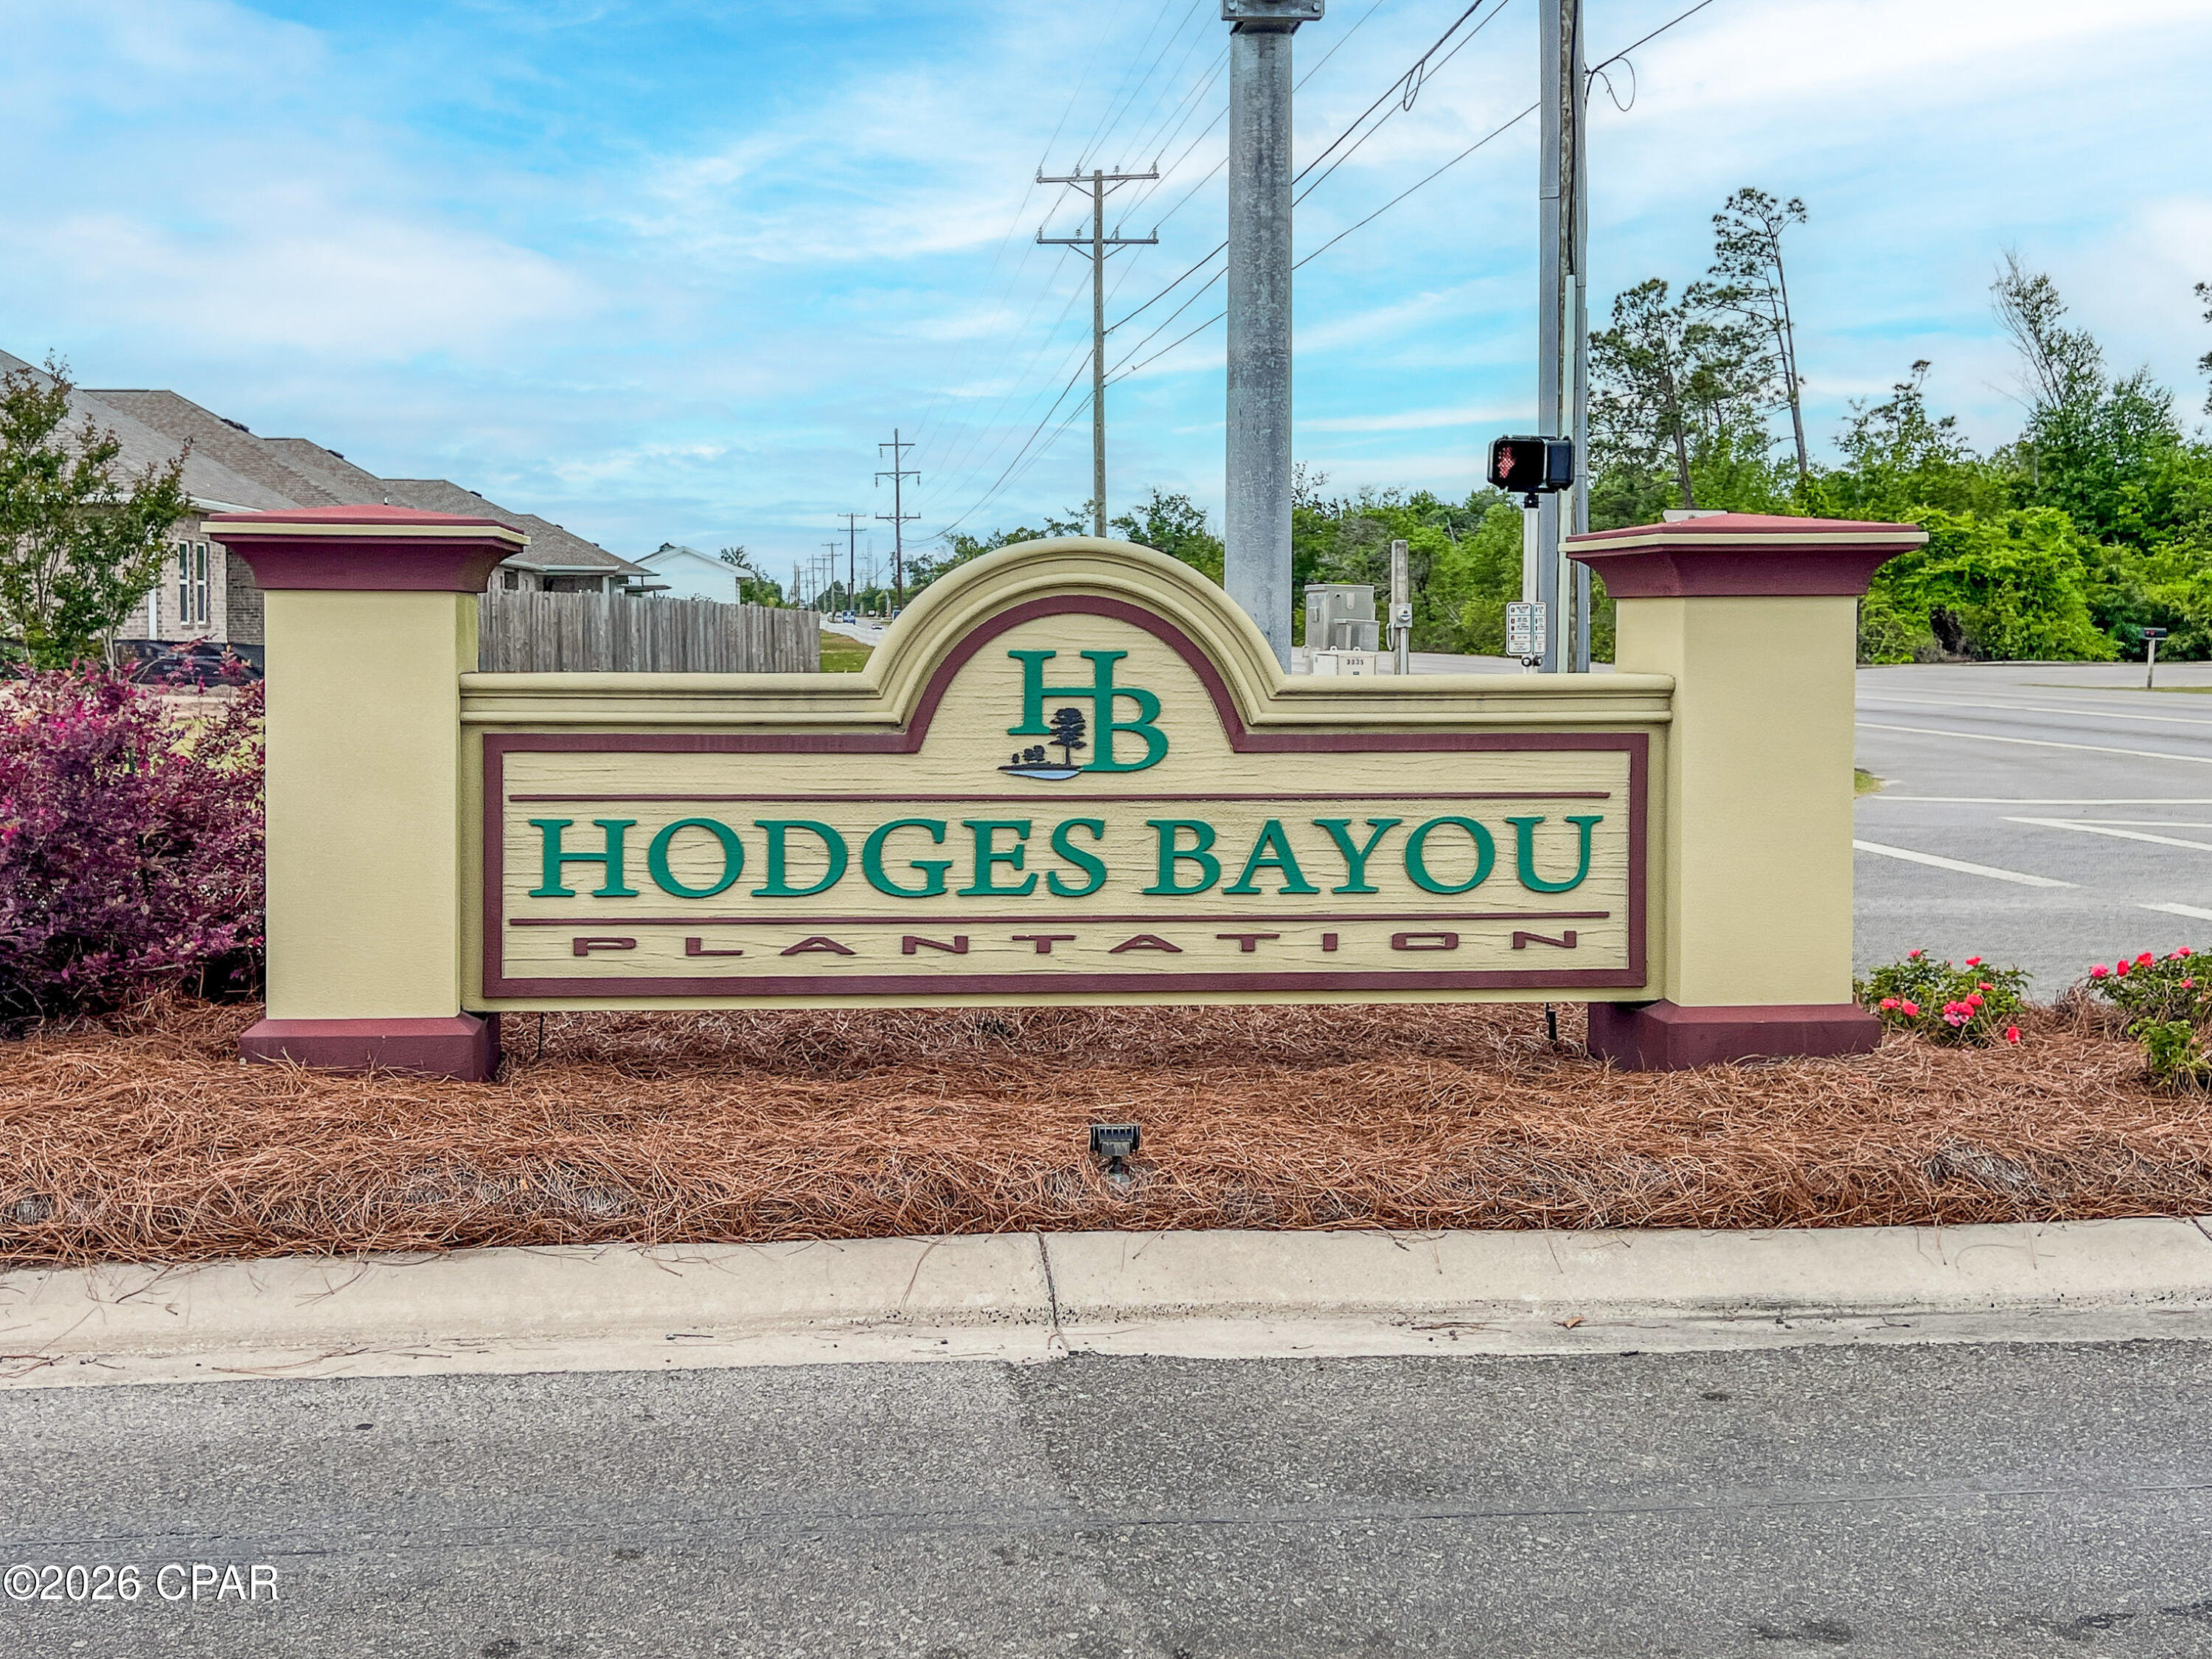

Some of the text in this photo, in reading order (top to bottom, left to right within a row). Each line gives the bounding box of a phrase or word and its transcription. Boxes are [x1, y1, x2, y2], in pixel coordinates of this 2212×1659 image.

[1007, 650, 1169, 773] HB
[529, 815, 1604, 899] HODGES BAYOU
[573, 930, 1577, 956] PLANTATION
